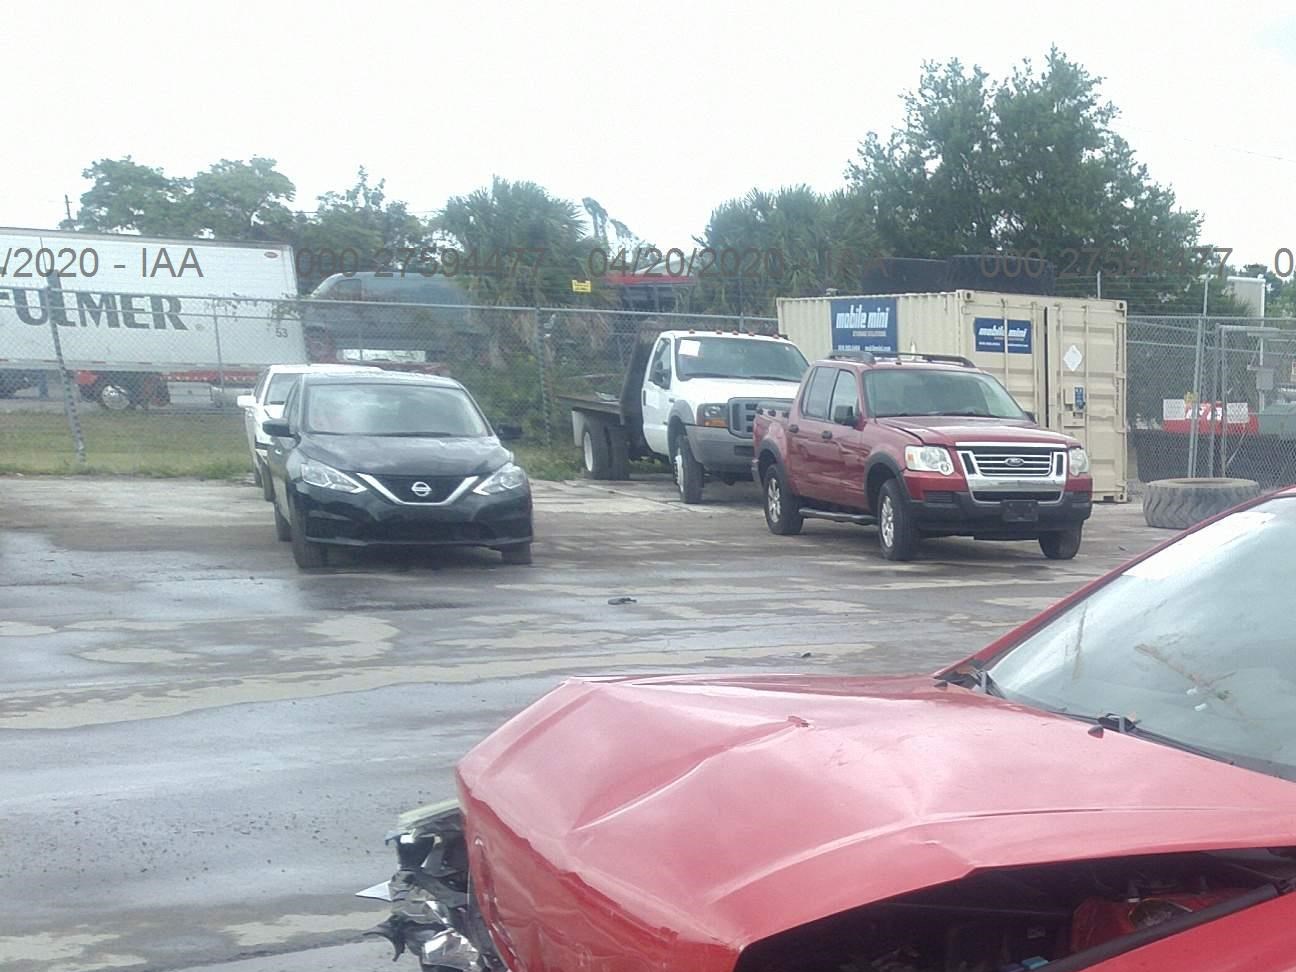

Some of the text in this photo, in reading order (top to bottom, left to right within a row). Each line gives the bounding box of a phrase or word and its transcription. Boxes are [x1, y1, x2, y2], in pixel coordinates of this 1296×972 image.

[0, 287, 189, 330] ULMER
[836, 304, 890, 329] mobile mini
[275, 328, 288, 338] 53
[978, 325, 1028, 338] mobil mini
